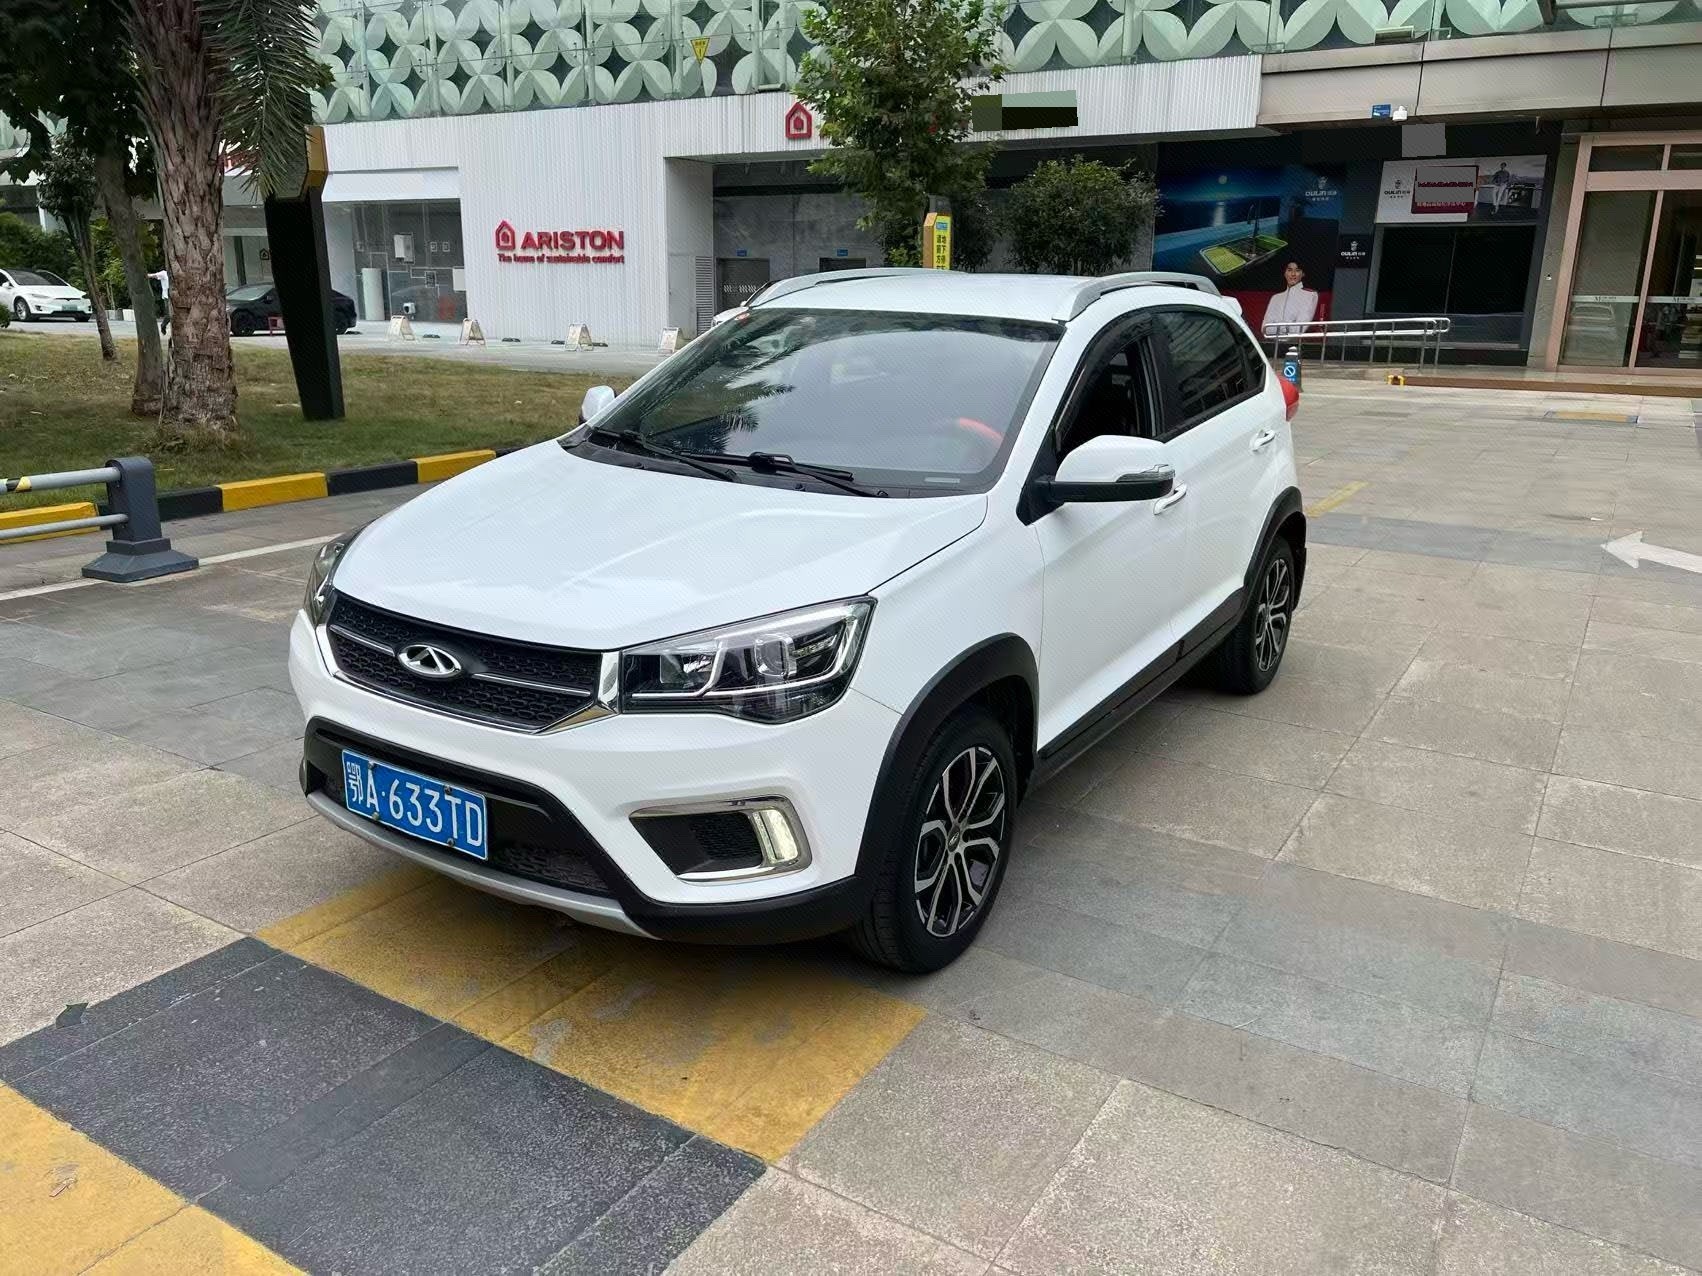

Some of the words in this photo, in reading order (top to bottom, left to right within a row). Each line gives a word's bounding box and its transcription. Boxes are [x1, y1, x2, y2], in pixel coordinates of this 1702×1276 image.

[521, 230, 625, 251] ARISTON
[498, 254, 512, 262] The
[513, 254, 535, 262] home
[537, 254, 545, 262] of
[546, 254, 590, 263] sustainable
[592, 255, 625, 264] comfort
